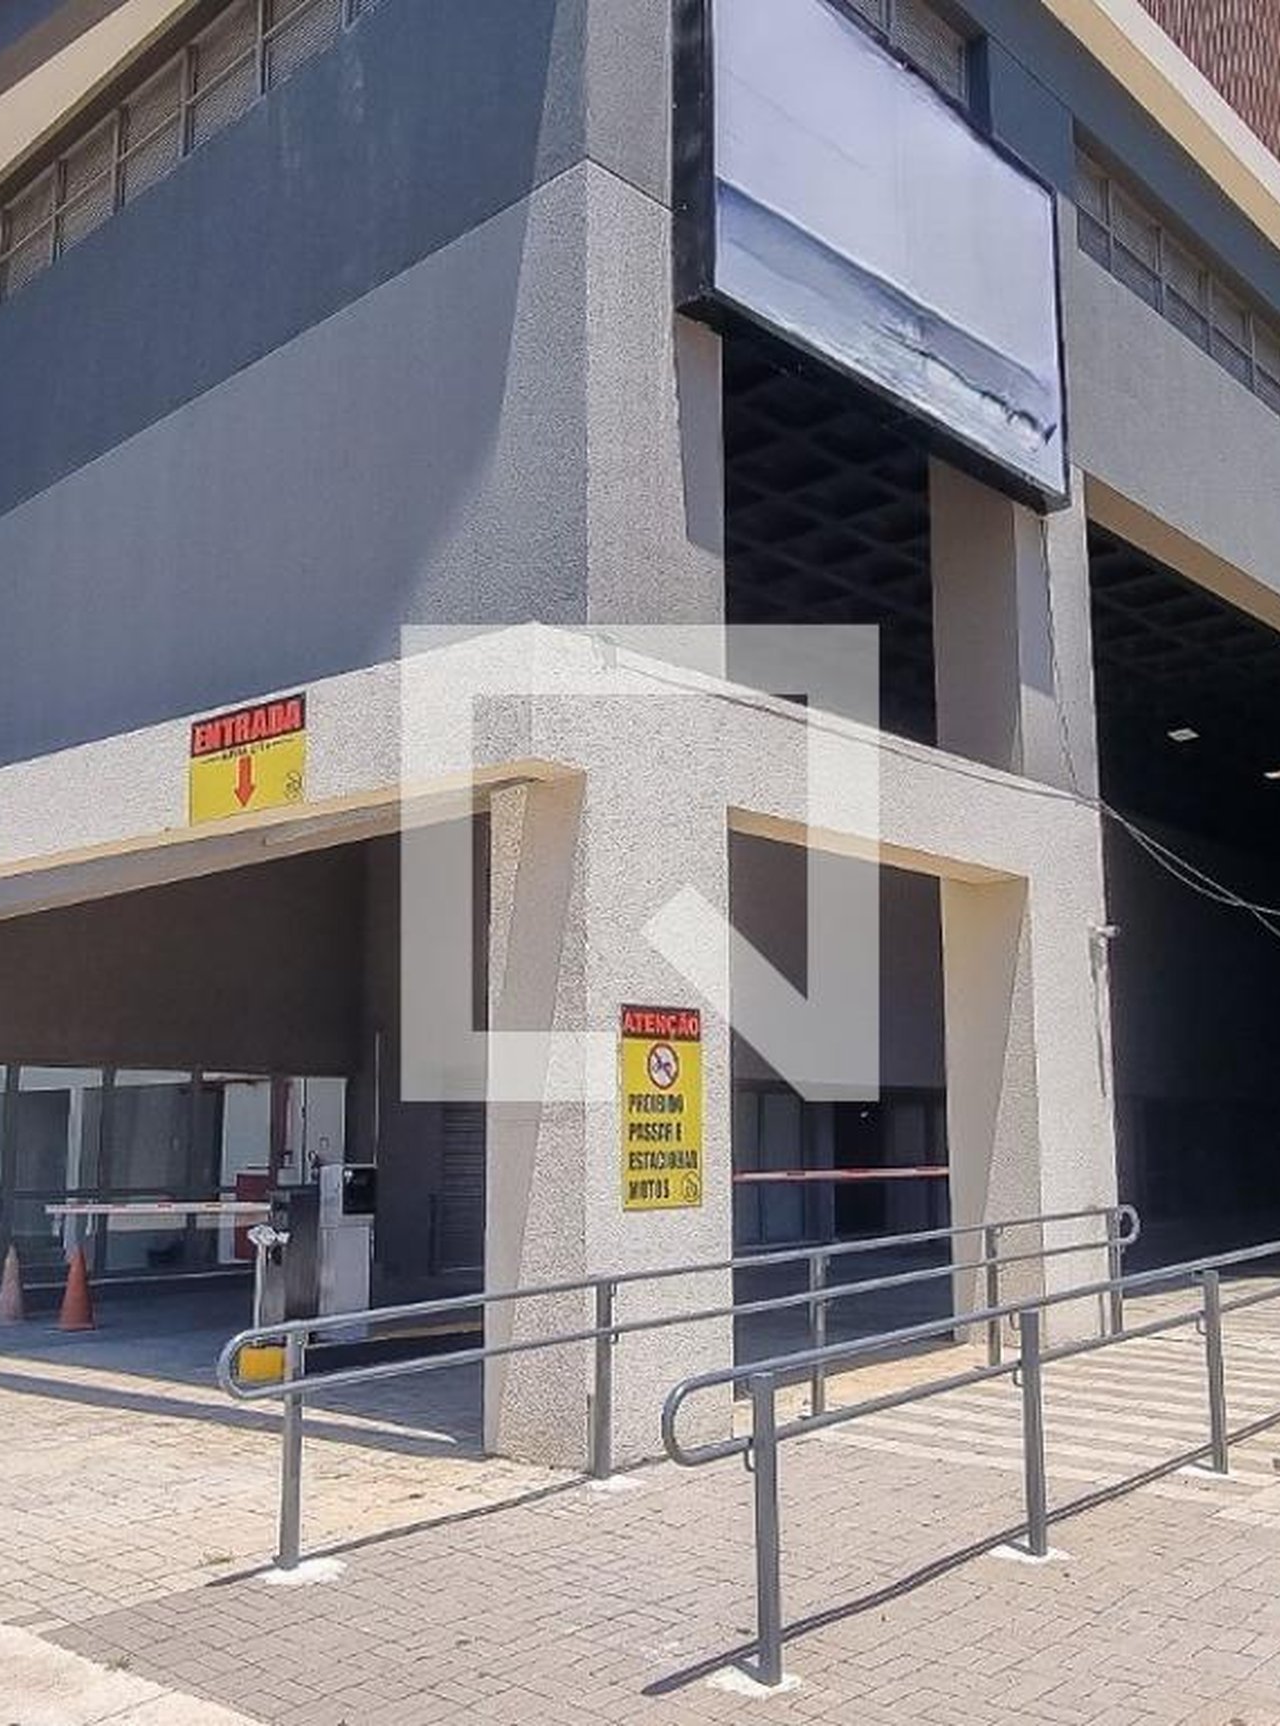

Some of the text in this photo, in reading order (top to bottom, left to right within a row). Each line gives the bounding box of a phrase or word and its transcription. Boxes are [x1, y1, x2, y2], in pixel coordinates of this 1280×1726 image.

[194, 699, 302, 755] ENTRADA
[625, 1010, 699, 1037] ATENÇÃO
[628, 1178, 670, 1200] MOTOS
